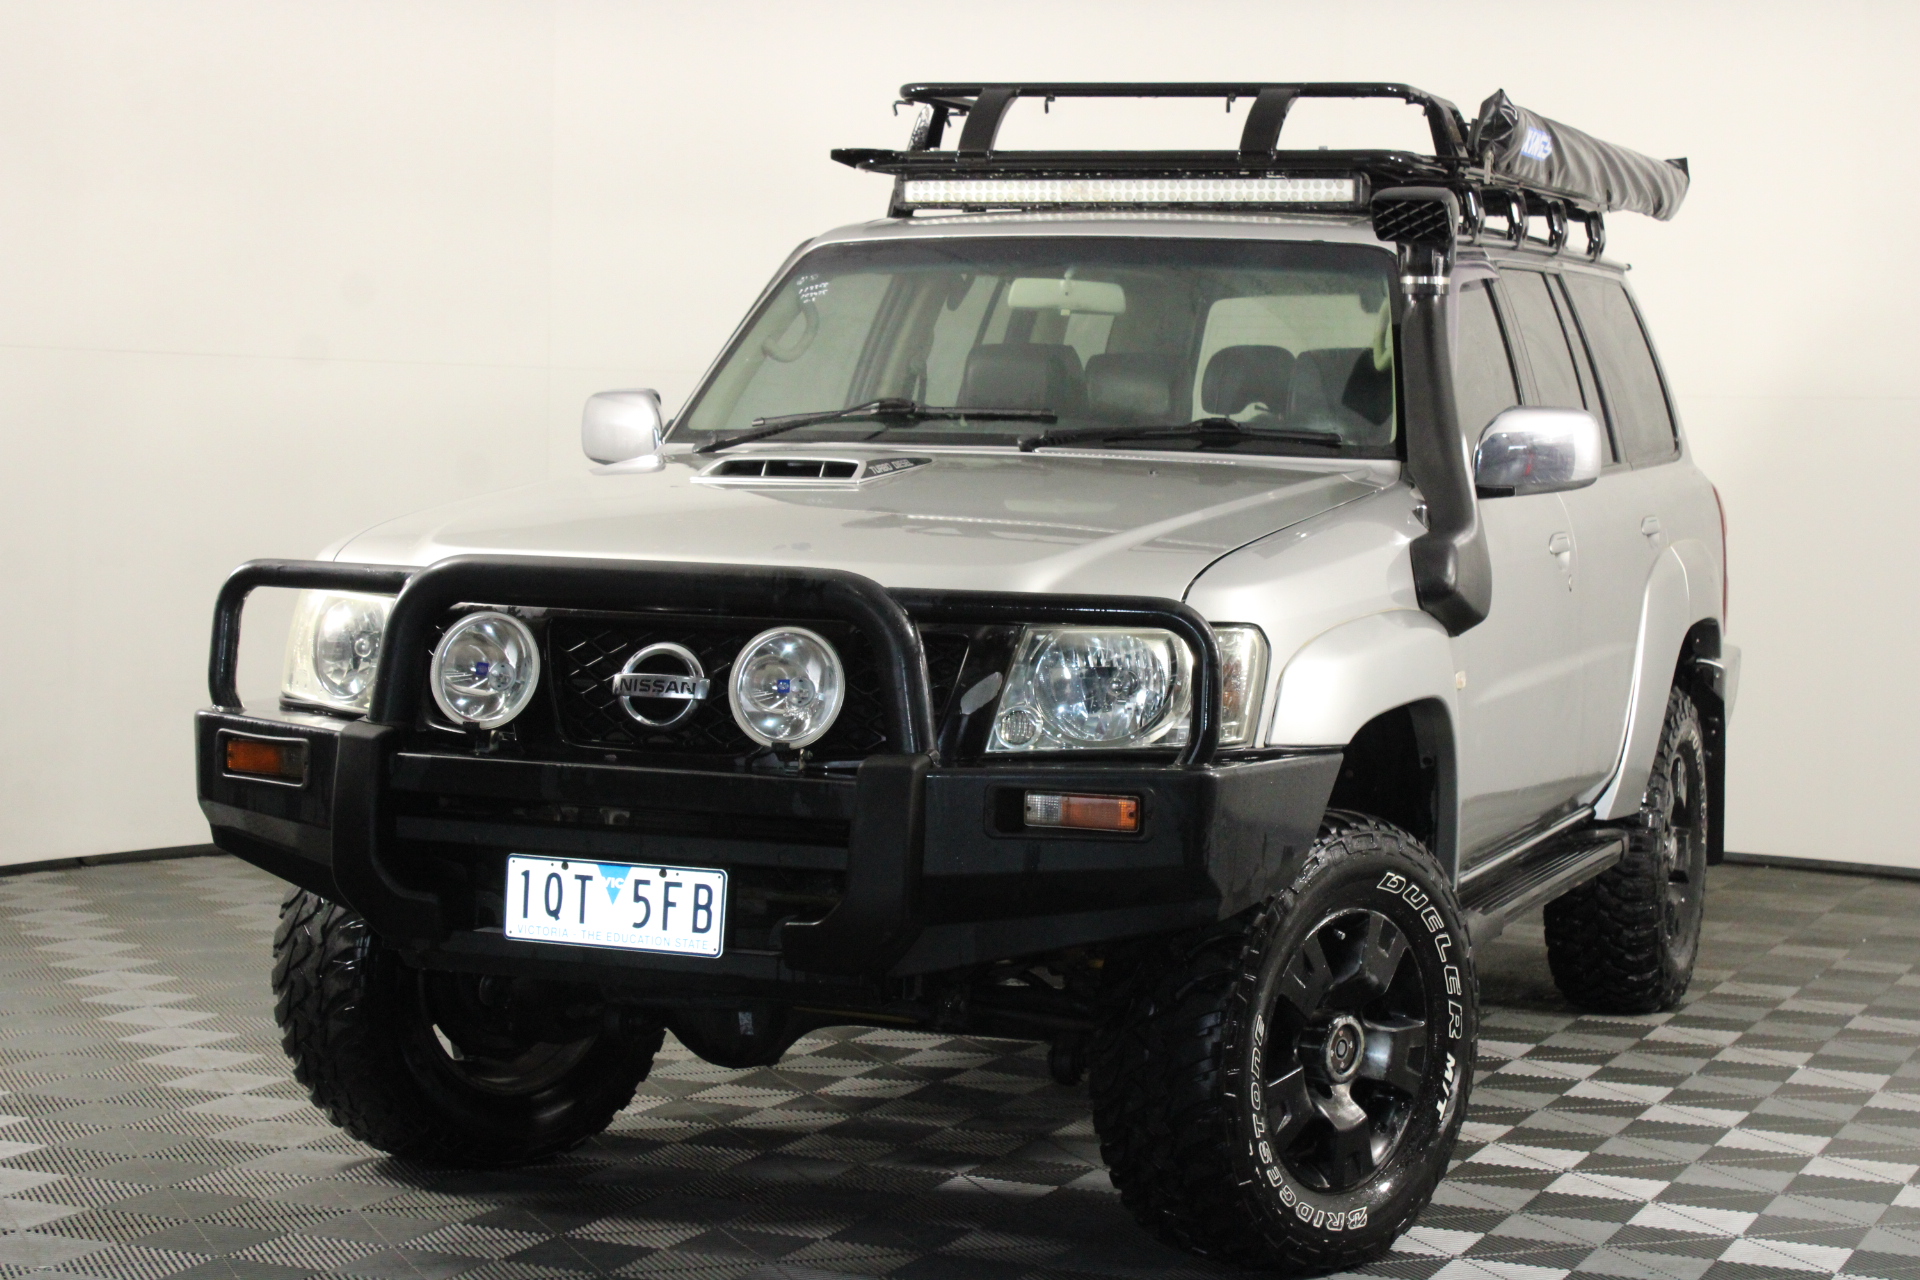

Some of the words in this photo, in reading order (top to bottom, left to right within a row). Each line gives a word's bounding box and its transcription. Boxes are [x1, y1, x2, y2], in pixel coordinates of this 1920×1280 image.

[868, 462, 893, 474] TURBO
[619, 677, 697, 695] NISSAN
[521, 869, 594, 924] 1QT
[632, 878, 713, 934] 5FB
[518, 924, 569, 938] VICTORIA
[582, 930, 602, 941] THE
[607, 932, 670, 947] EDUCATION
[675, 938, 709, 950] STATE
[1376, 871, 1463, 1040] DUELER
[1436, 1051, 1456, 1121] M/T
[1249, 1014, 1368, 1232] BRIDGESTONE
